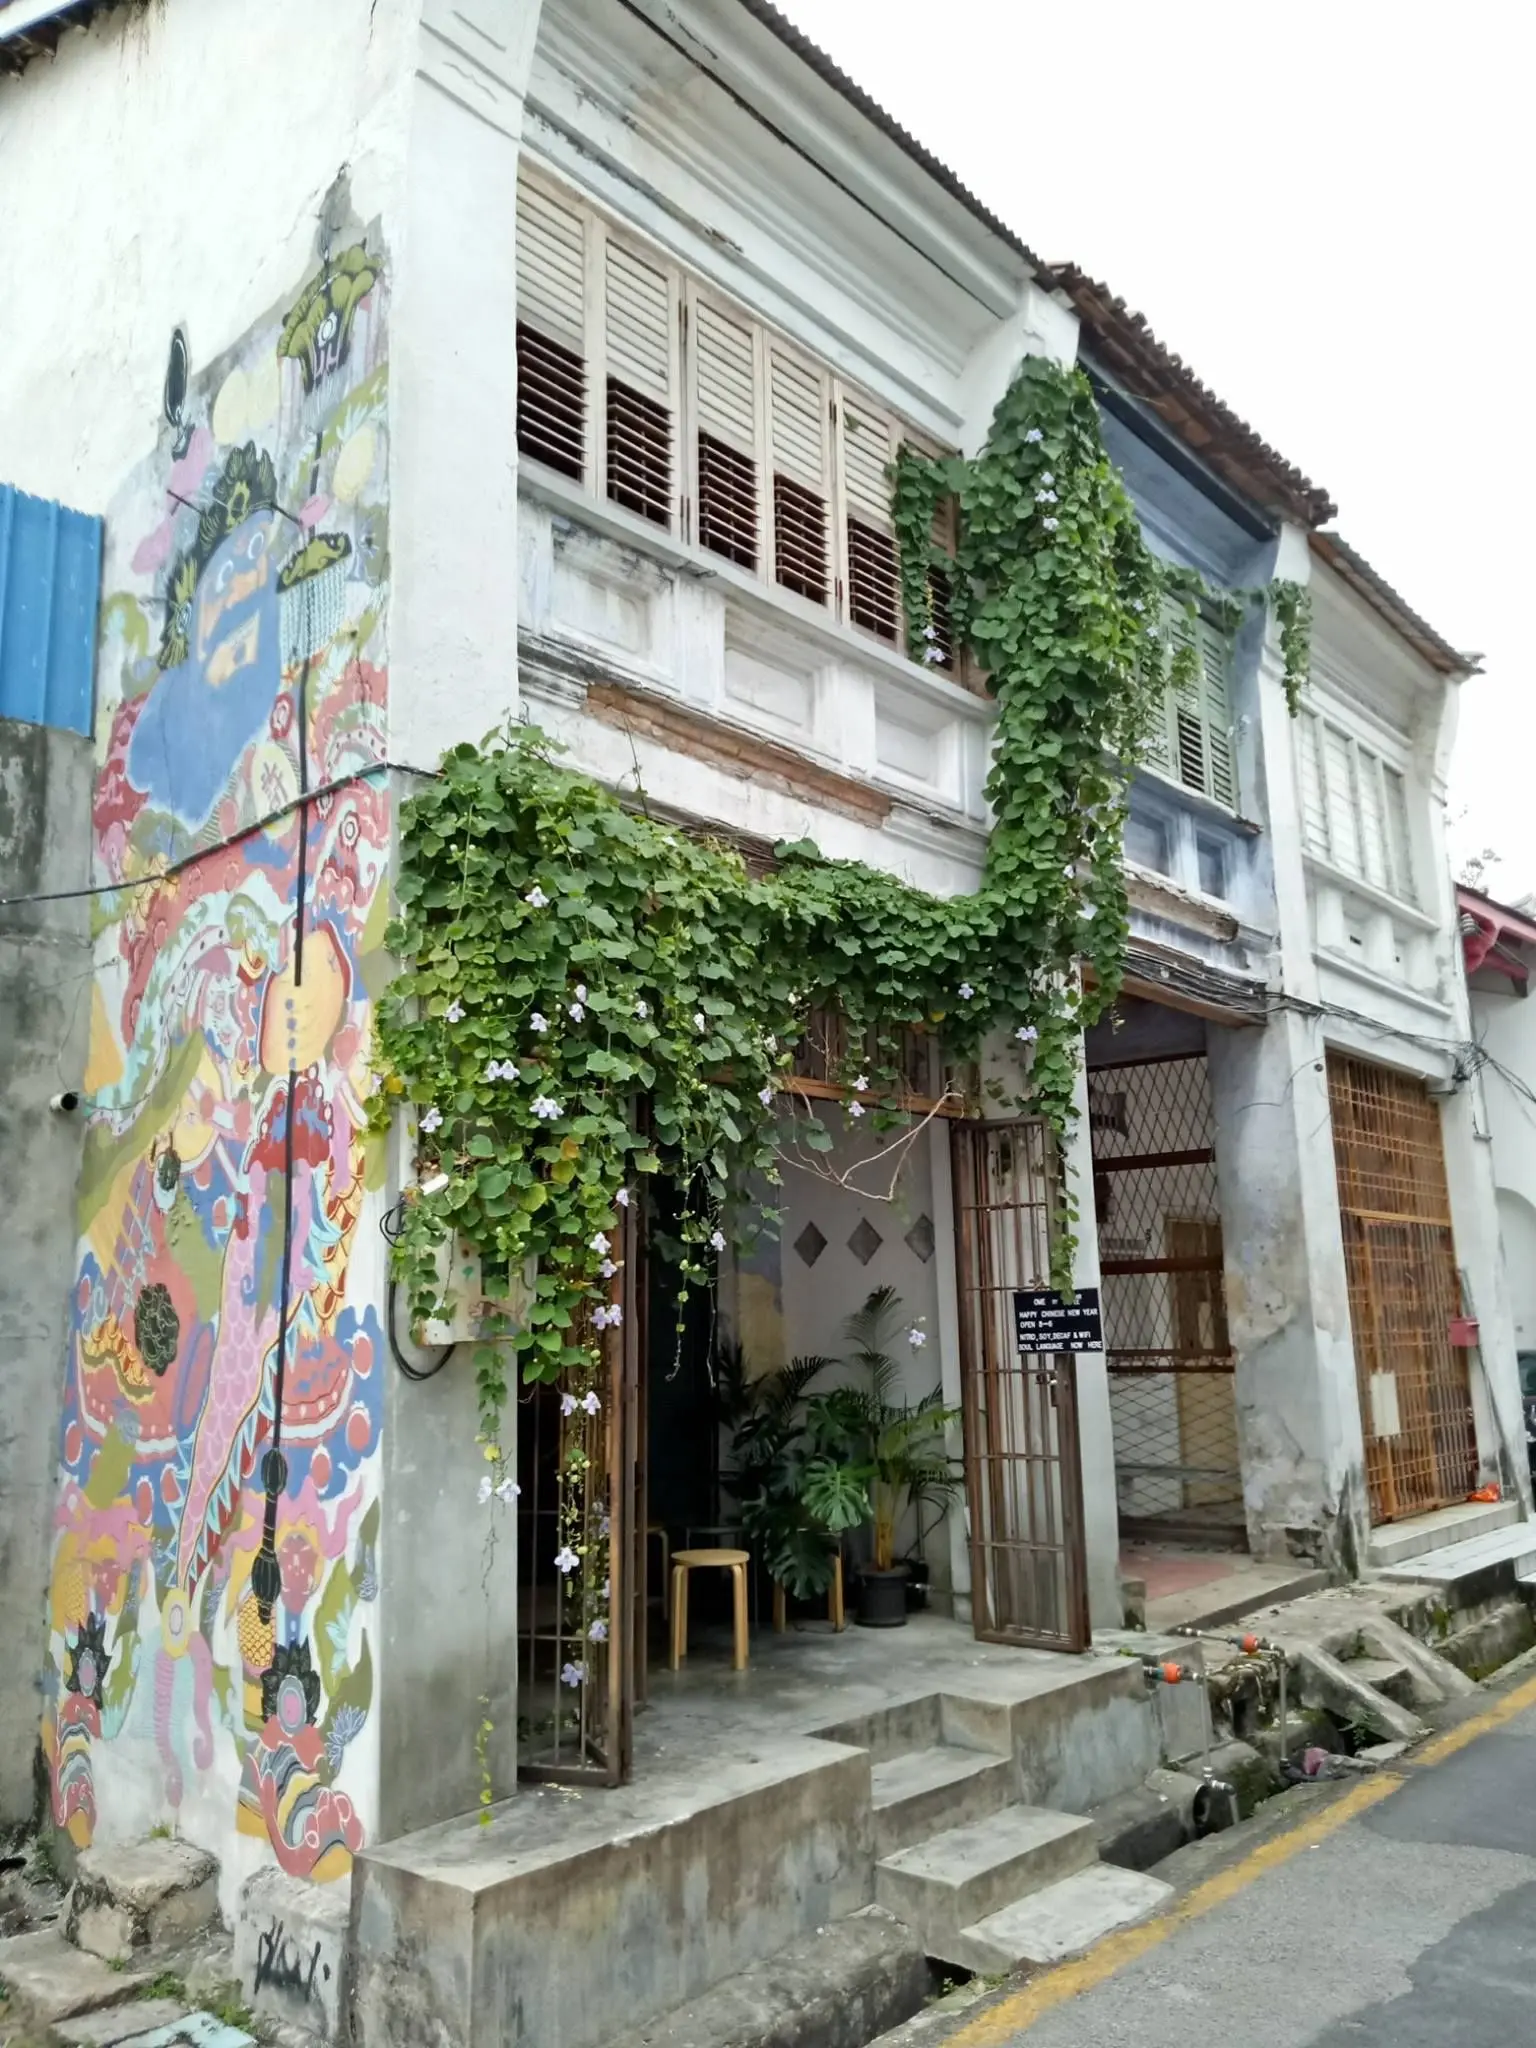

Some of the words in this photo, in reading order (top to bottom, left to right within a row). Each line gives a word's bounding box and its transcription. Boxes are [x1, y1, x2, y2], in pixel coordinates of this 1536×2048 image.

[1041, 1310, 1065, 1318] CHINESE
[1067, 1309, 1081, 1317] NEW
[1082, 1308, 1098, 1316] YEAR
[1020, 1321, 1036, 1329] OPEN
[1079, 1331, 1091, 1339] WIFI
[1019, 1343, 1033, 1351] SOUL
[1036, 1342, 1064, 1350] LANGUAGE
[1087, 1341, 1102, 1349] HERE
